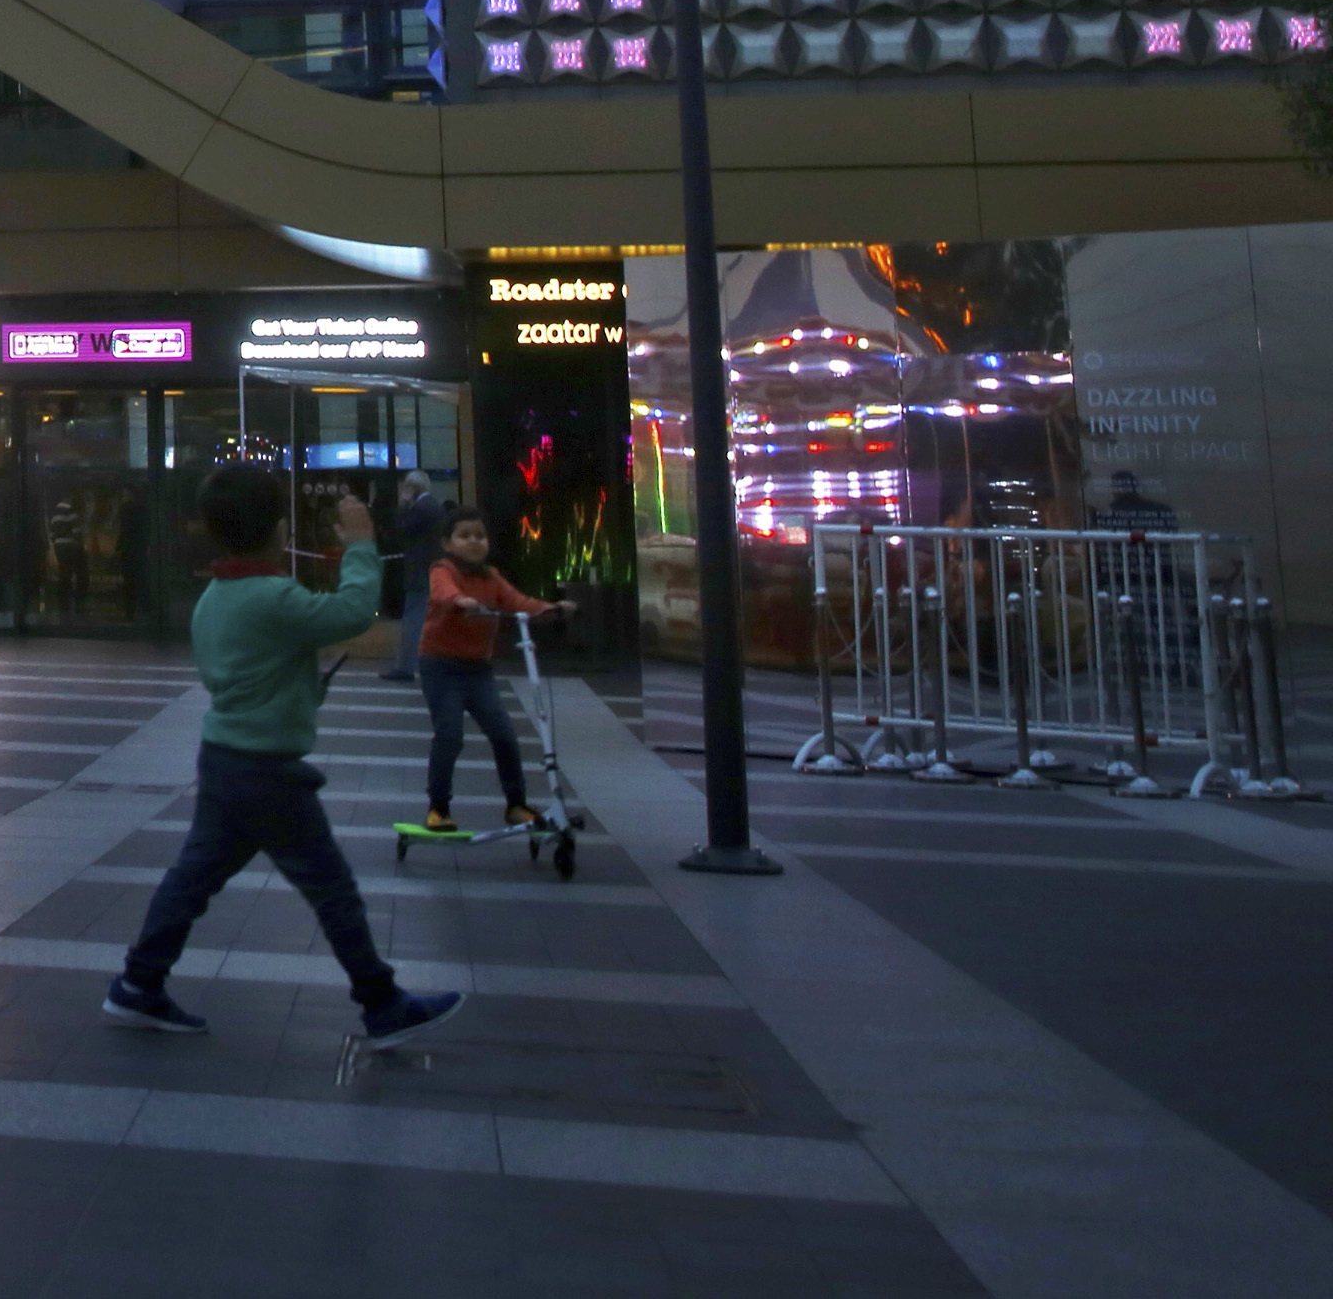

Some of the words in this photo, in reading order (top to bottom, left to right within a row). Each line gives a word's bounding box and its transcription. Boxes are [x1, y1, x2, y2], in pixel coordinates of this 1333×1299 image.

[489, 278, 616, 301] Roadster
[517, 320, 601, 344] zaatar
[1087, 387, 1217, 407] DAZZLING
[1089, 413, 1202, 434] INFINITY
[1091, 441, 1164, 461] LIGHT
[1173, 440, 1255, 461] SPACE
